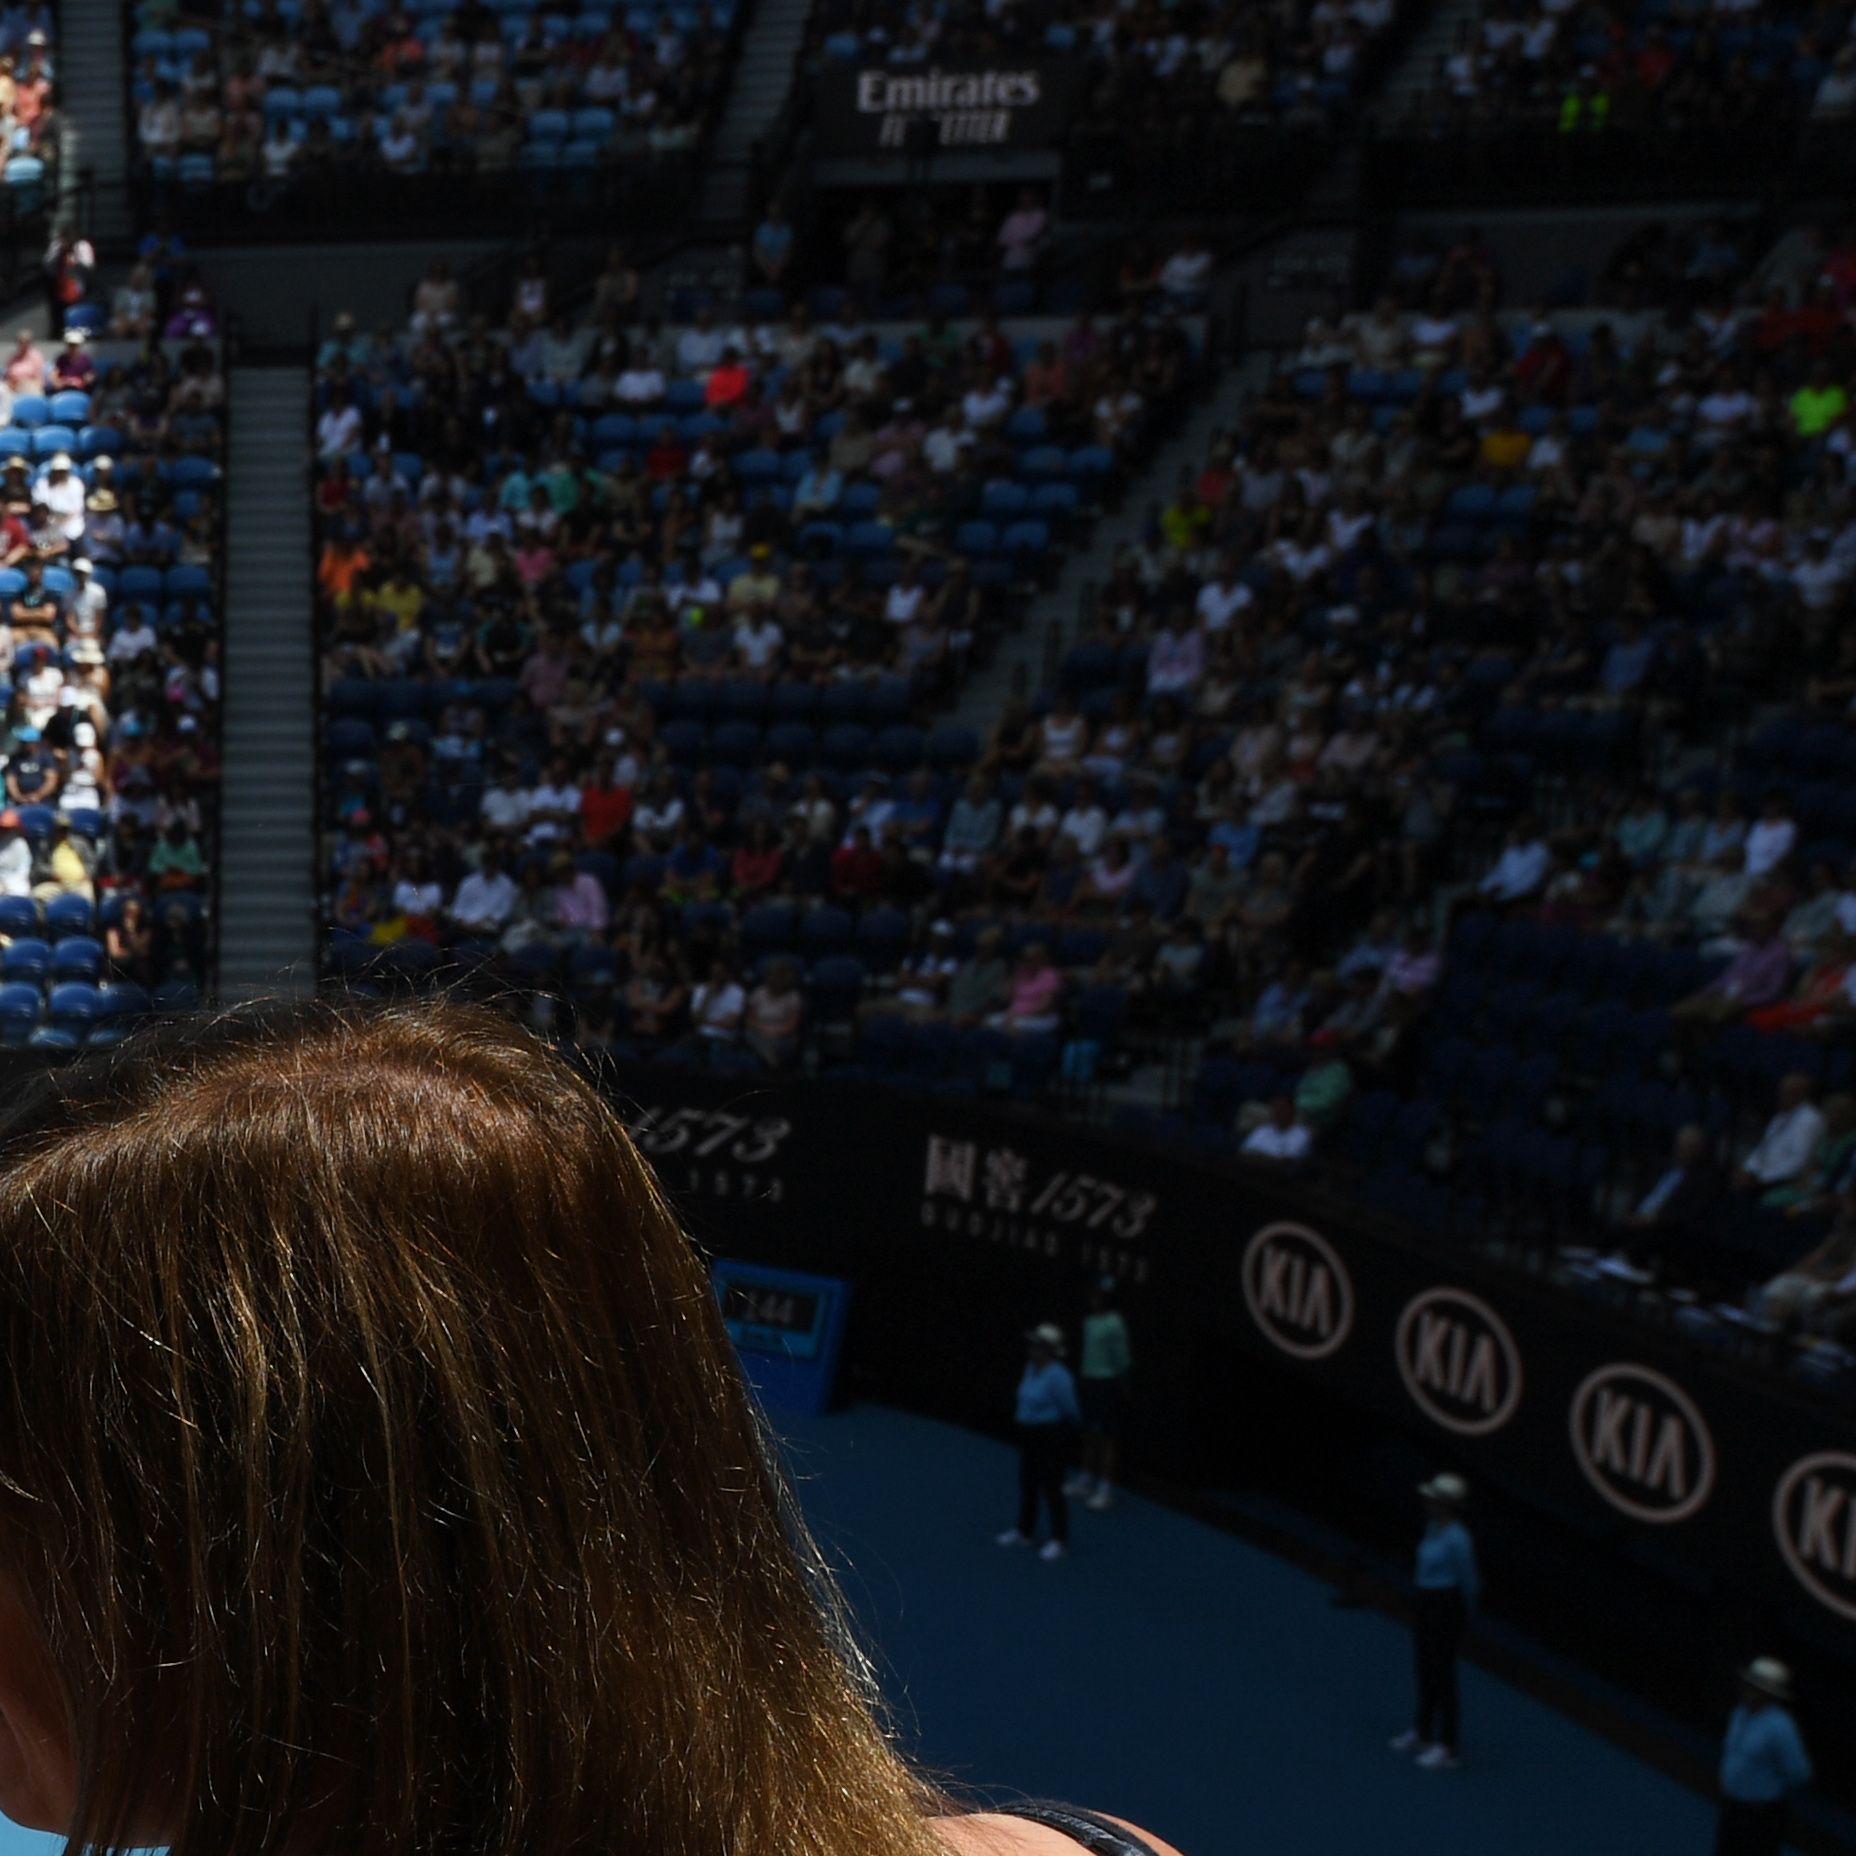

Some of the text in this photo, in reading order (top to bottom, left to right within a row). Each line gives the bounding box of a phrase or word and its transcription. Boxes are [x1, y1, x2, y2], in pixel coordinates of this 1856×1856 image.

[856, 66, 1040, 113] Emirates
[1259, 1245, 1335, 1341] KIA
[1414, 1310, 1497, 1414] KIA
[1594, 1387, 1688, 1502] KIA
